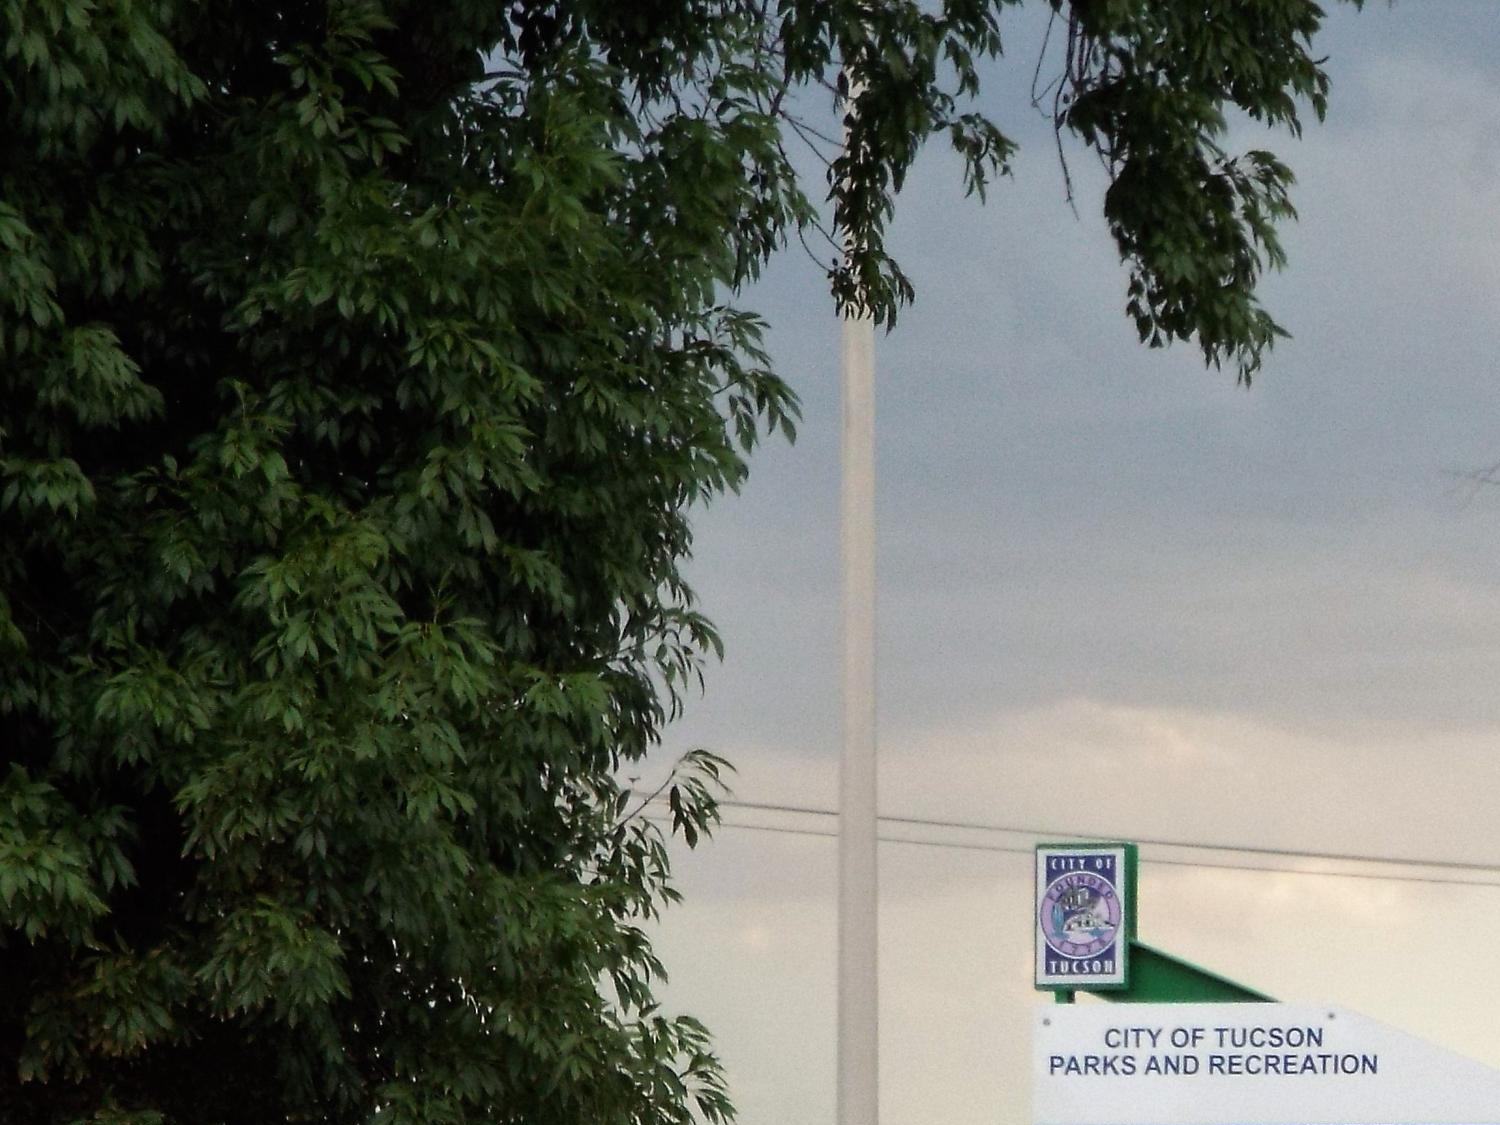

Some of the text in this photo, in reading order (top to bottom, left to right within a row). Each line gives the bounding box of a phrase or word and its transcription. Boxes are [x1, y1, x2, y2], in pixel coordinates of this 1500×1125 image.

[1051, 858, 1112, 871] CITY OF
[1050, 960, 1113, 974] TUCSON
[1104, 1027, 1324, 1048] CITY OF TUCSON
[1049, 1054, 1378, 1076] PARKS AND RECREATION
